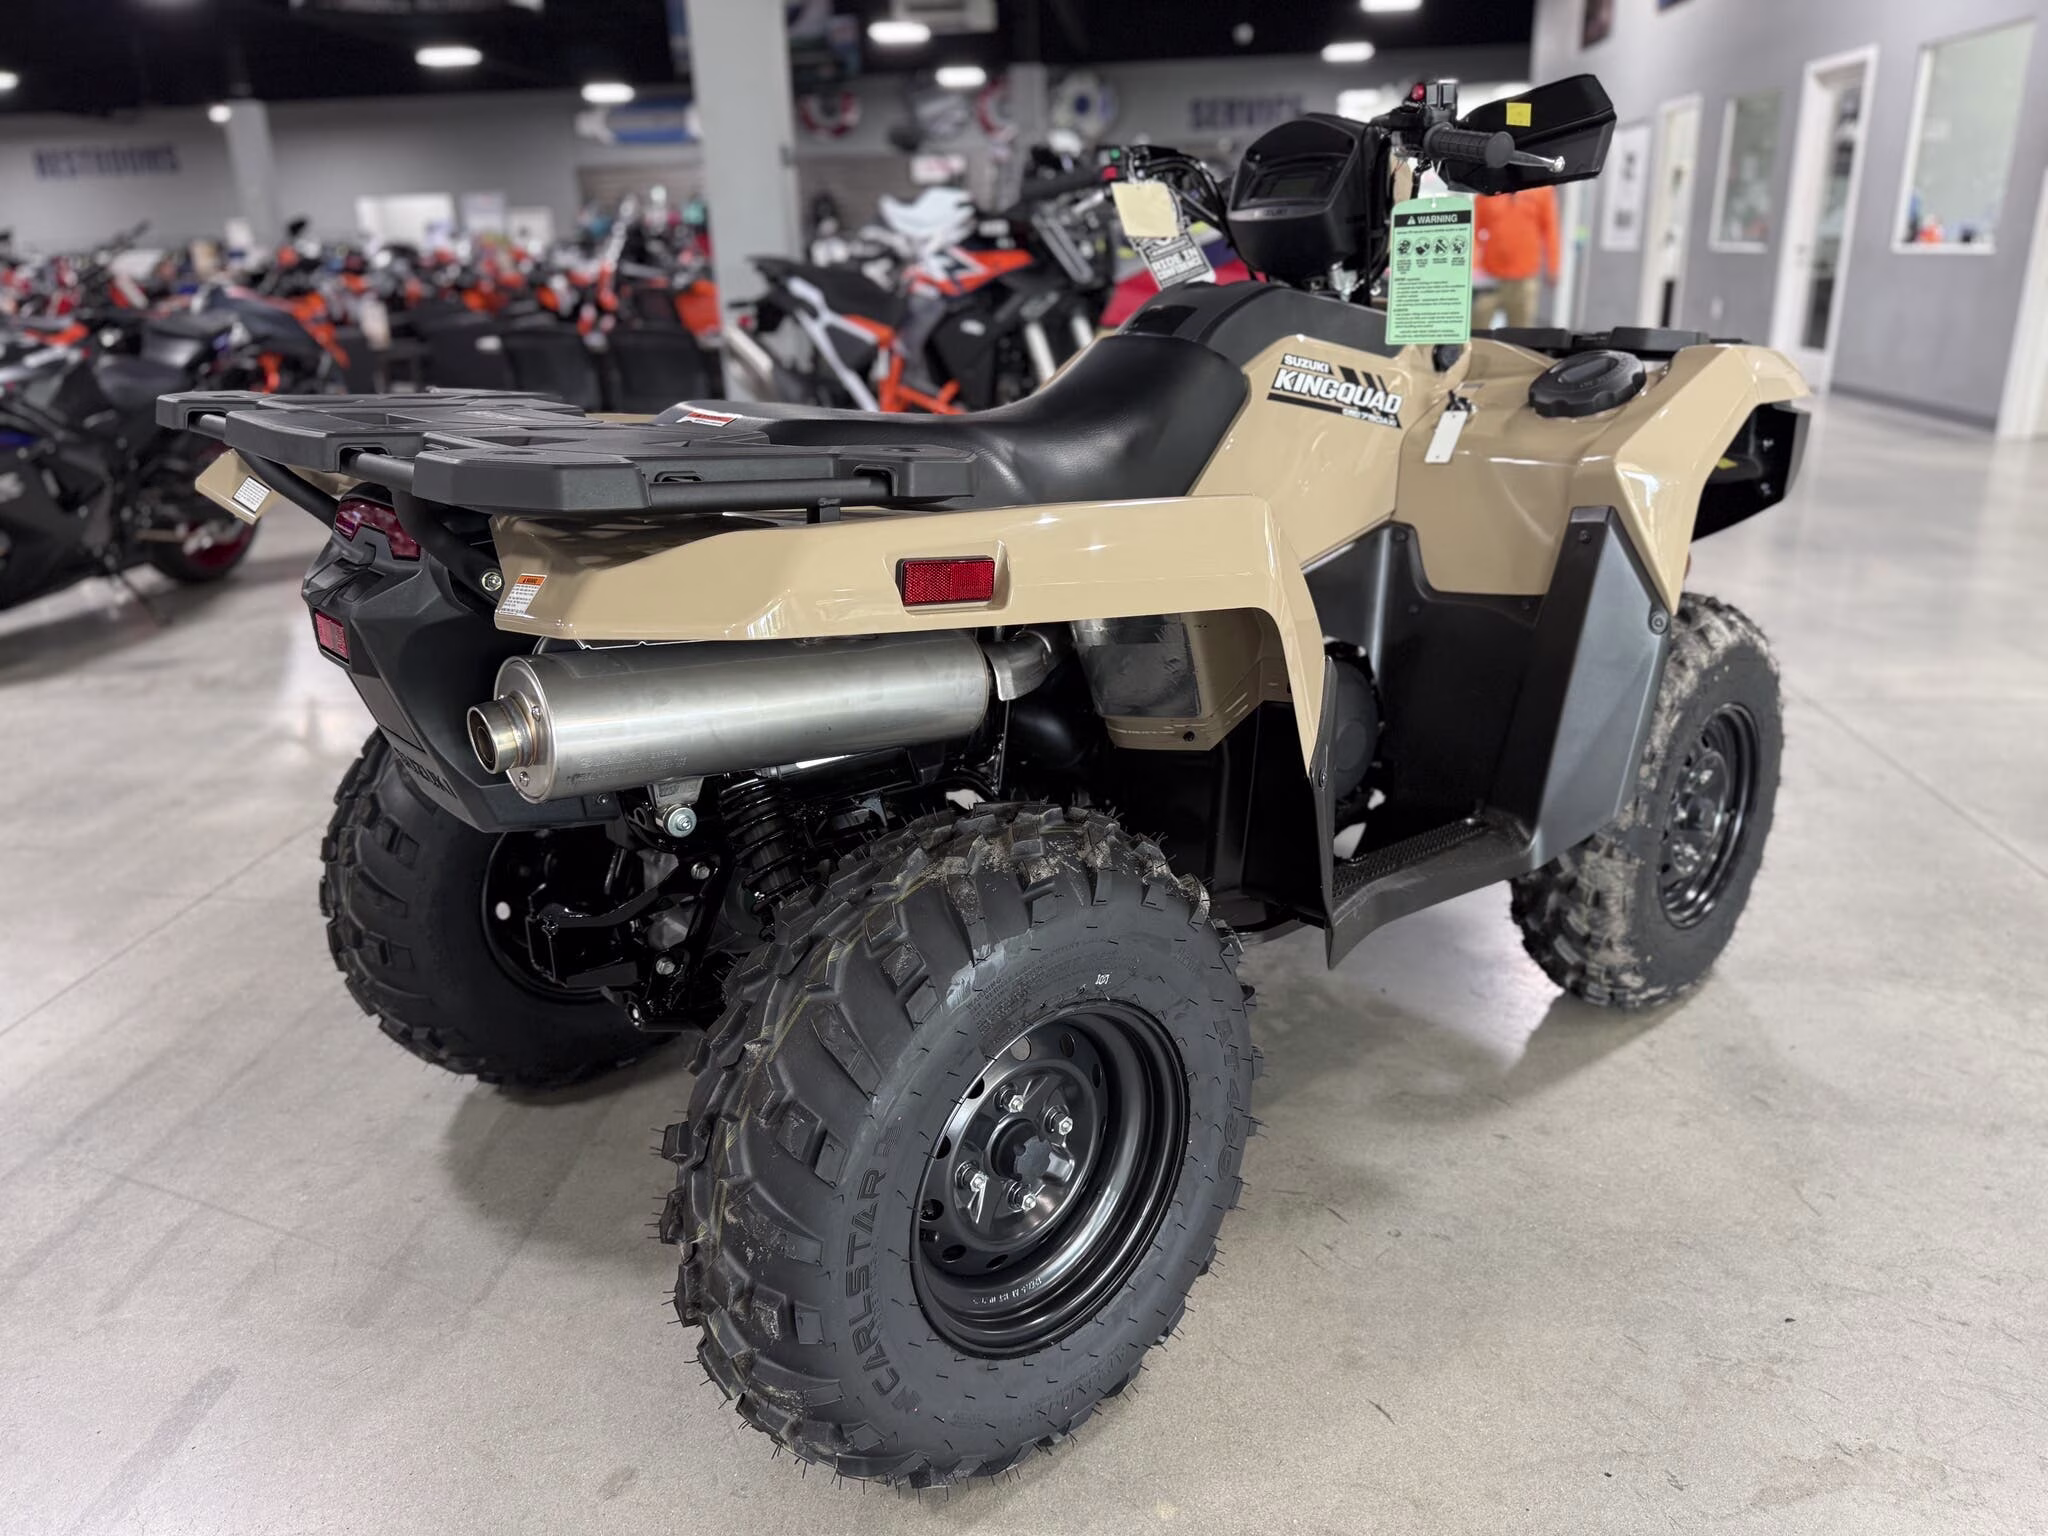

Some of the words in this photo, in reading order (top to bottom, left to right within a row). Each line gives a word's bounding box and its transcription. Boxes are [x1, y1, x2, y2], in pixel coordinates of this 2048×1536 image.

[1417, 213, 1458, 224] WARNING
[1284, 354, 1330, 373] SUZUKI
[1274, 368, 1403, 415] KINGQUAD
[393, 746, 459, 800] SUZUKI
